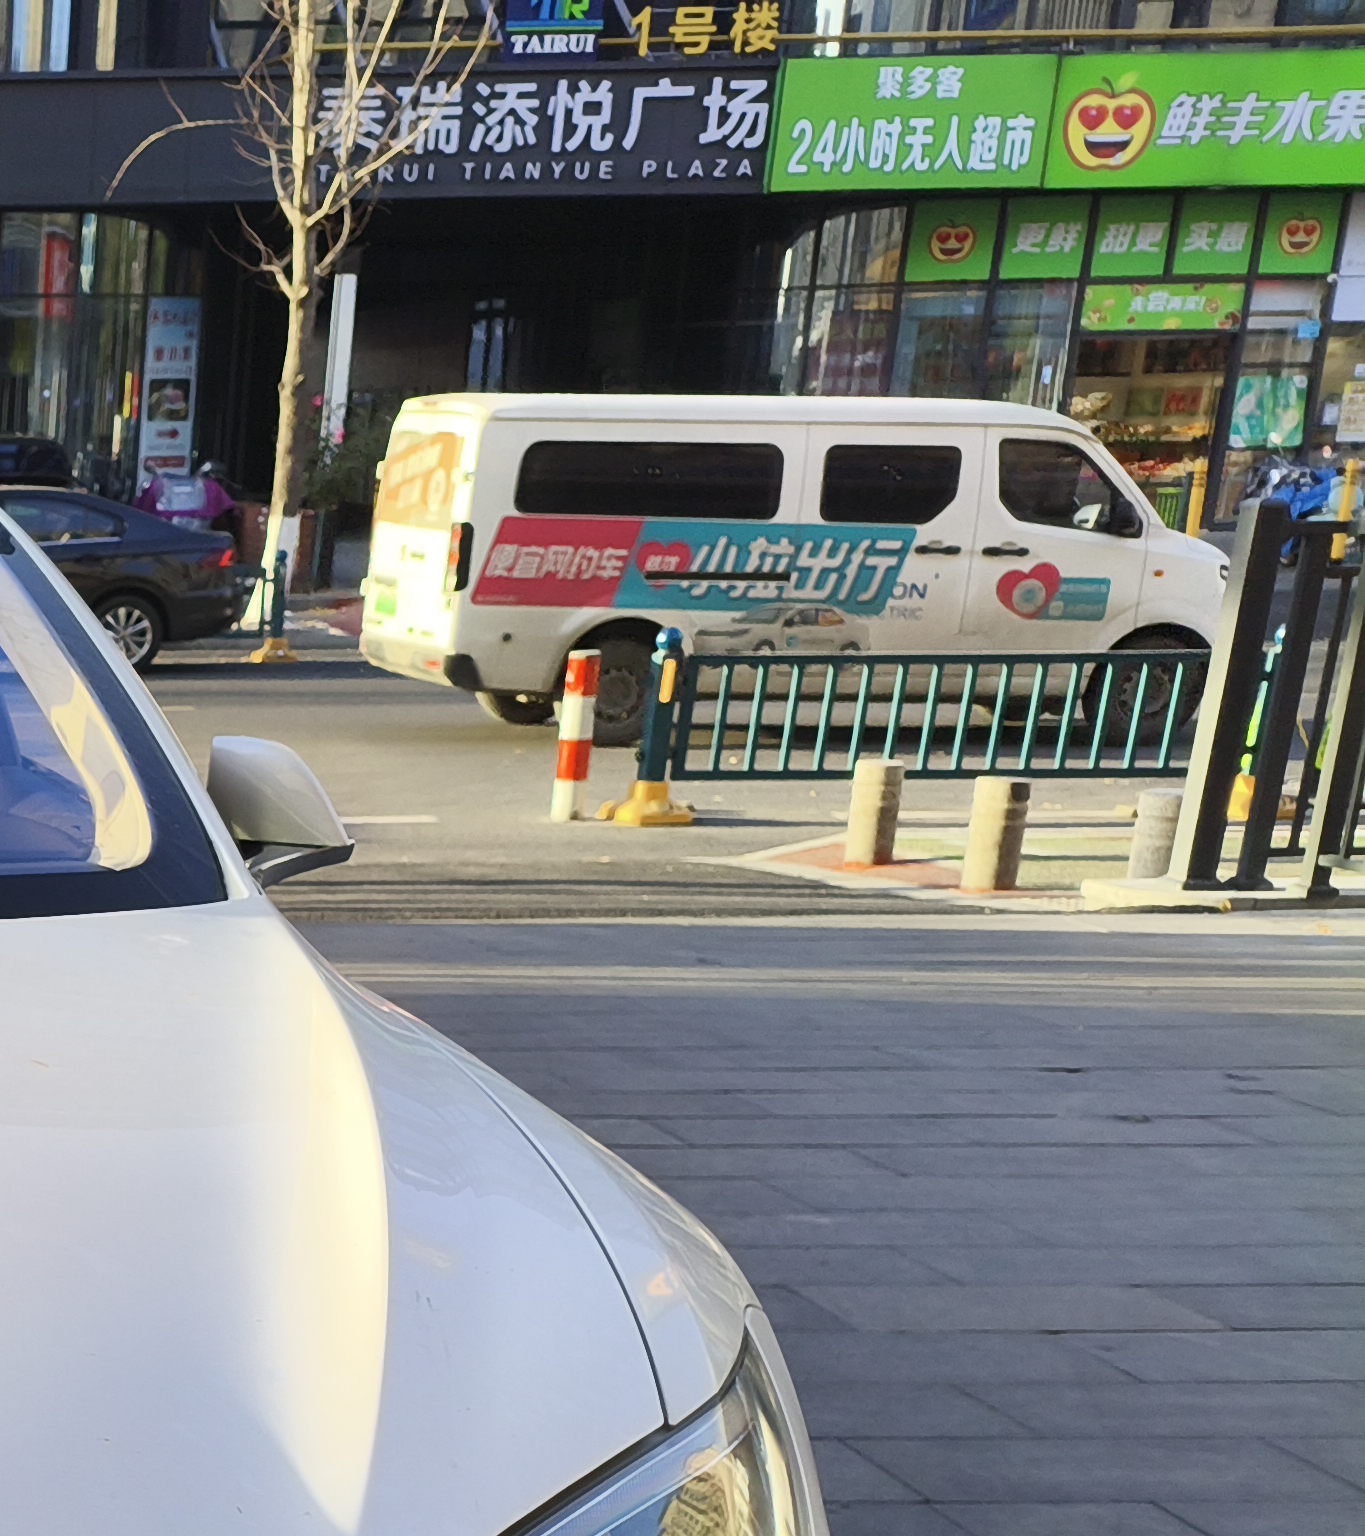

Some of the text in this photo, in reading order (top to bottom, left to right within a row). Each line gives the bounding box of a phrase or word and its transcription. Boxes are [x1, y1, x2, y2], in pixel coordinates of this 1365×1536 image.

[510, 34, 595, 55] TAIRUI
[631, 1, 780, 57] 1号楼
[875, 65, 965, 99] 聚多客
[317, 77, 769, 156] 泰瑞添悦广场
[787, 113, 1036, 173] 24小时无人超市
[1155, 90, 1365, 145] 鲜丰水果
[462, 160, 614, 181] TIANYUE
[641, 159, 753, 179] PLAZA
[485, 535, 904, 602] 便宜网约车 小拉出行
